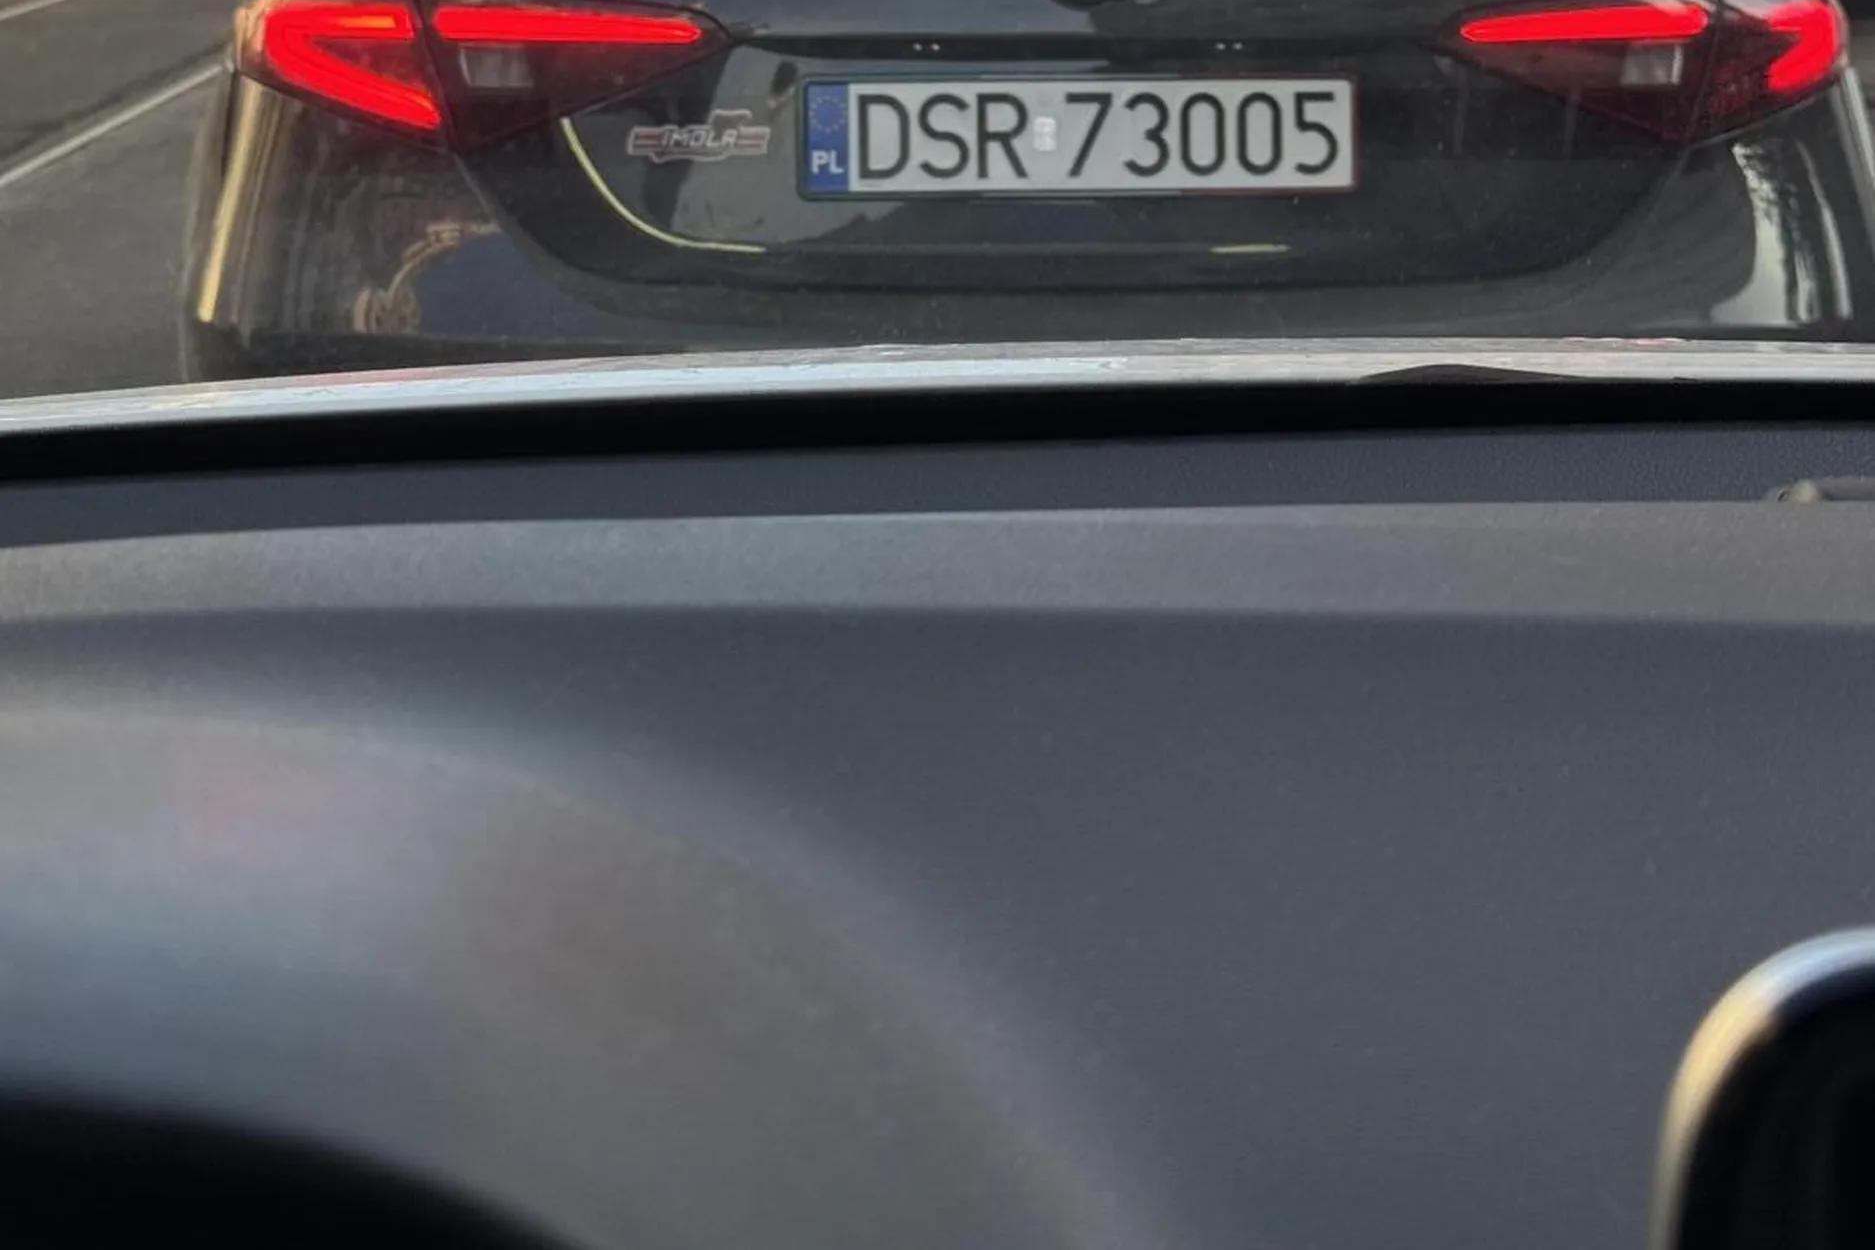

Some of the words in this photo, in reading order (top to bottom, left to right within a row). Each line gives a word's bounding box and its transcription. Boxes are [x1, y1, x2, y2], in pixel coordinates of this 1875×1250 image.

[810, 149, 845, 174] PL
[857, 92, 1028, 180] DSR
[1065, 91, 1339, 177] 73005
